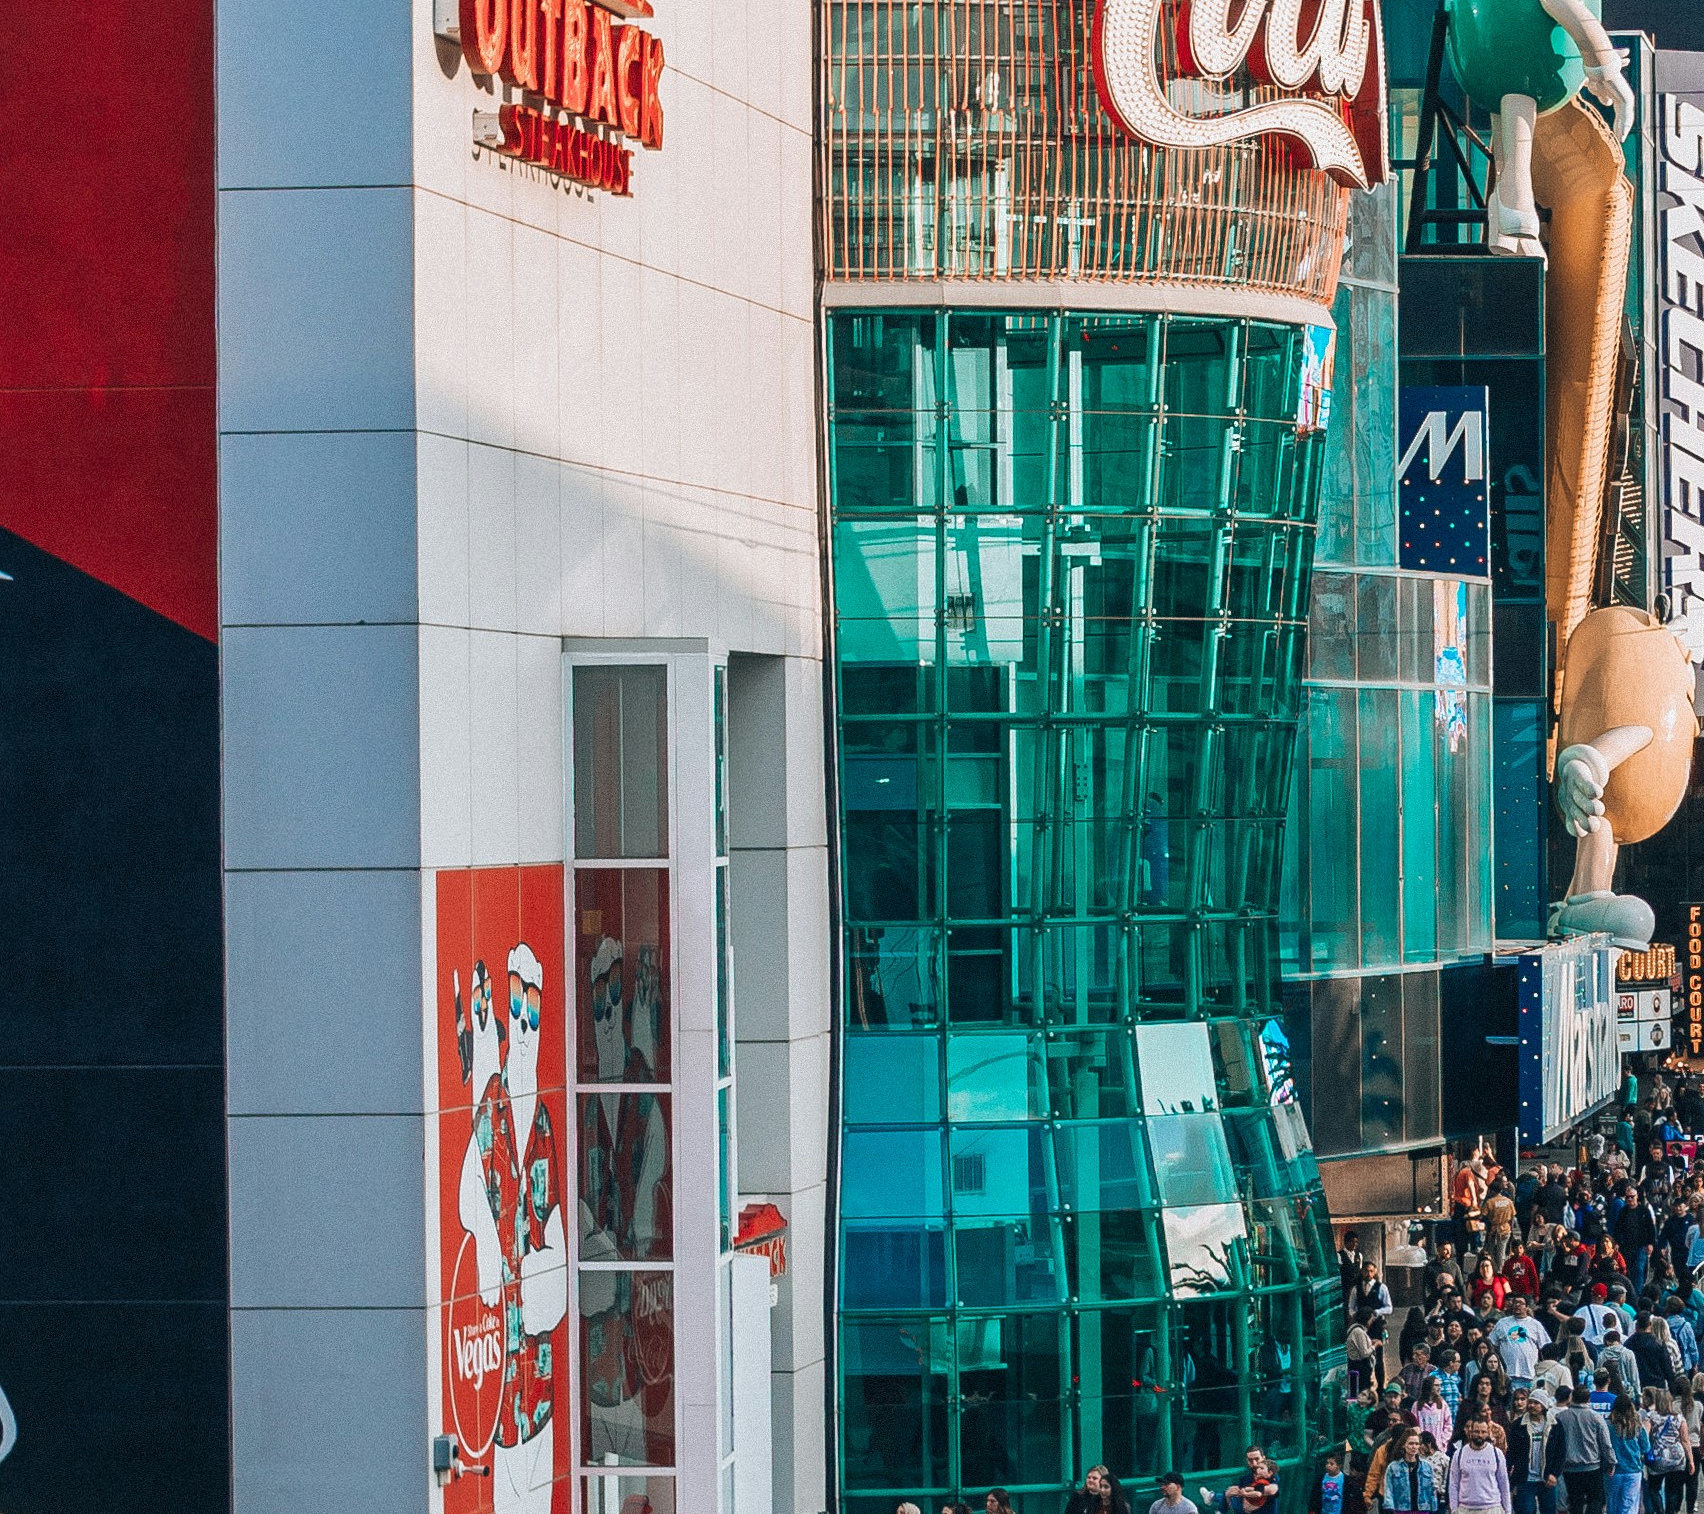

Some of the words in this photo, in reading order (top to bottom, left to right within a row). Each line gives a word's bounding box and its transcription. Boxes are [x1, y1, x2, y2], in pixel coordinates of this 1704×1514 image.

[496, 104, 634, 197] STEAKHOUSE
[1395, 411, 1483, 480] M
[1689, 906, 1702, 969] FOOD
[1689, 975, 1702, 1054] COURT
[454, 1329, 501, 1391] Vegas
